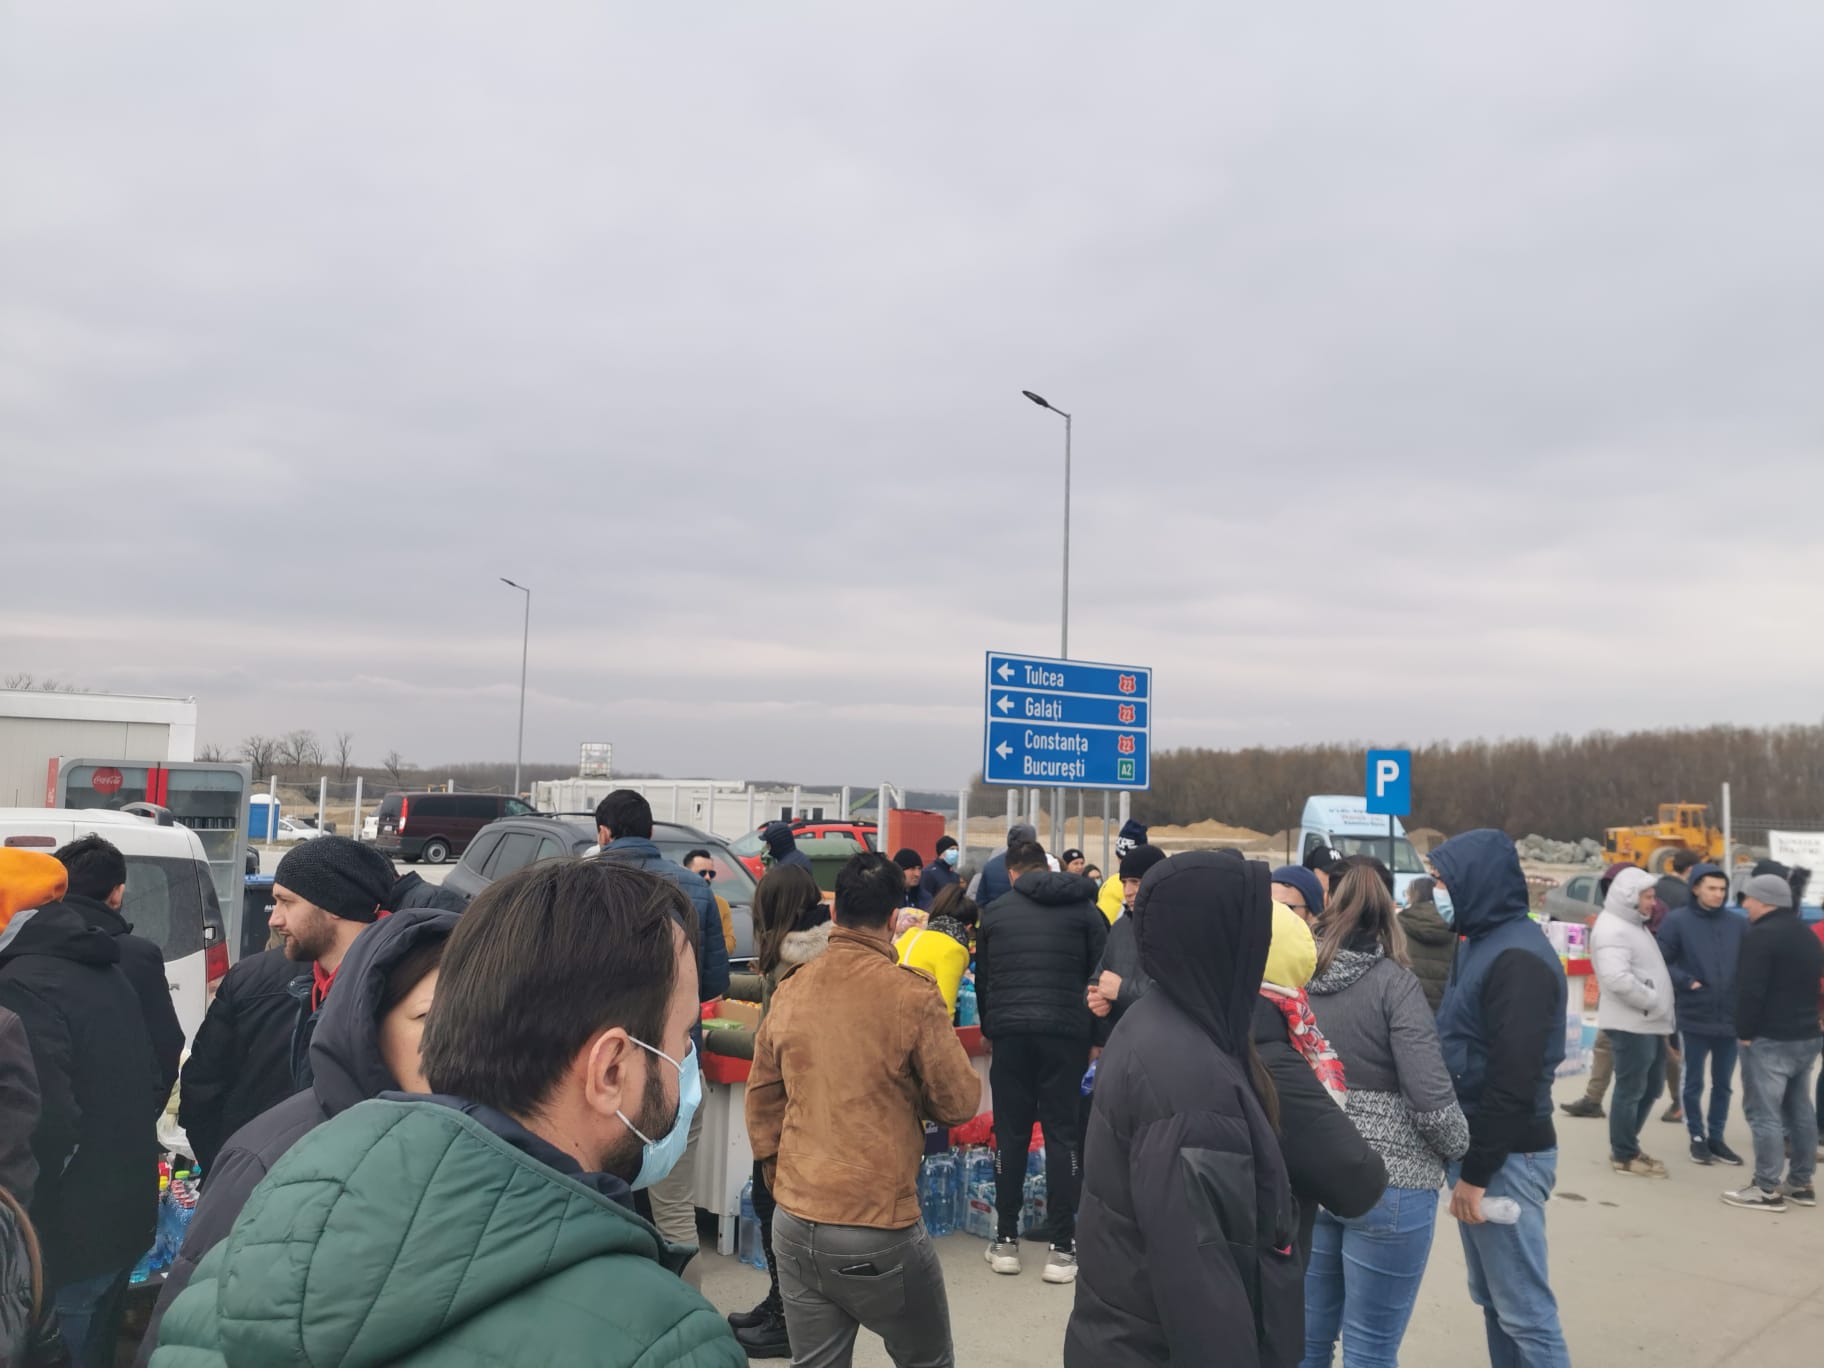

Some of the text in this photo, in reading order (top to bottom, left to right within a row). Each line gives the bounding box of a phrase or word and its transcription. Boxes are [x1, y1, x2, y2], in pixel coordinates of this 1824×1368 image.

[1024, 665, 1132, 690] Tulcea 22
[1025, 697, 1131, 721] Galați 22
[1024, 729, 1132, 755] Constanța 22
[1121, 763, 1132, 776] A2
[1377, 760, 1400, 797] P
